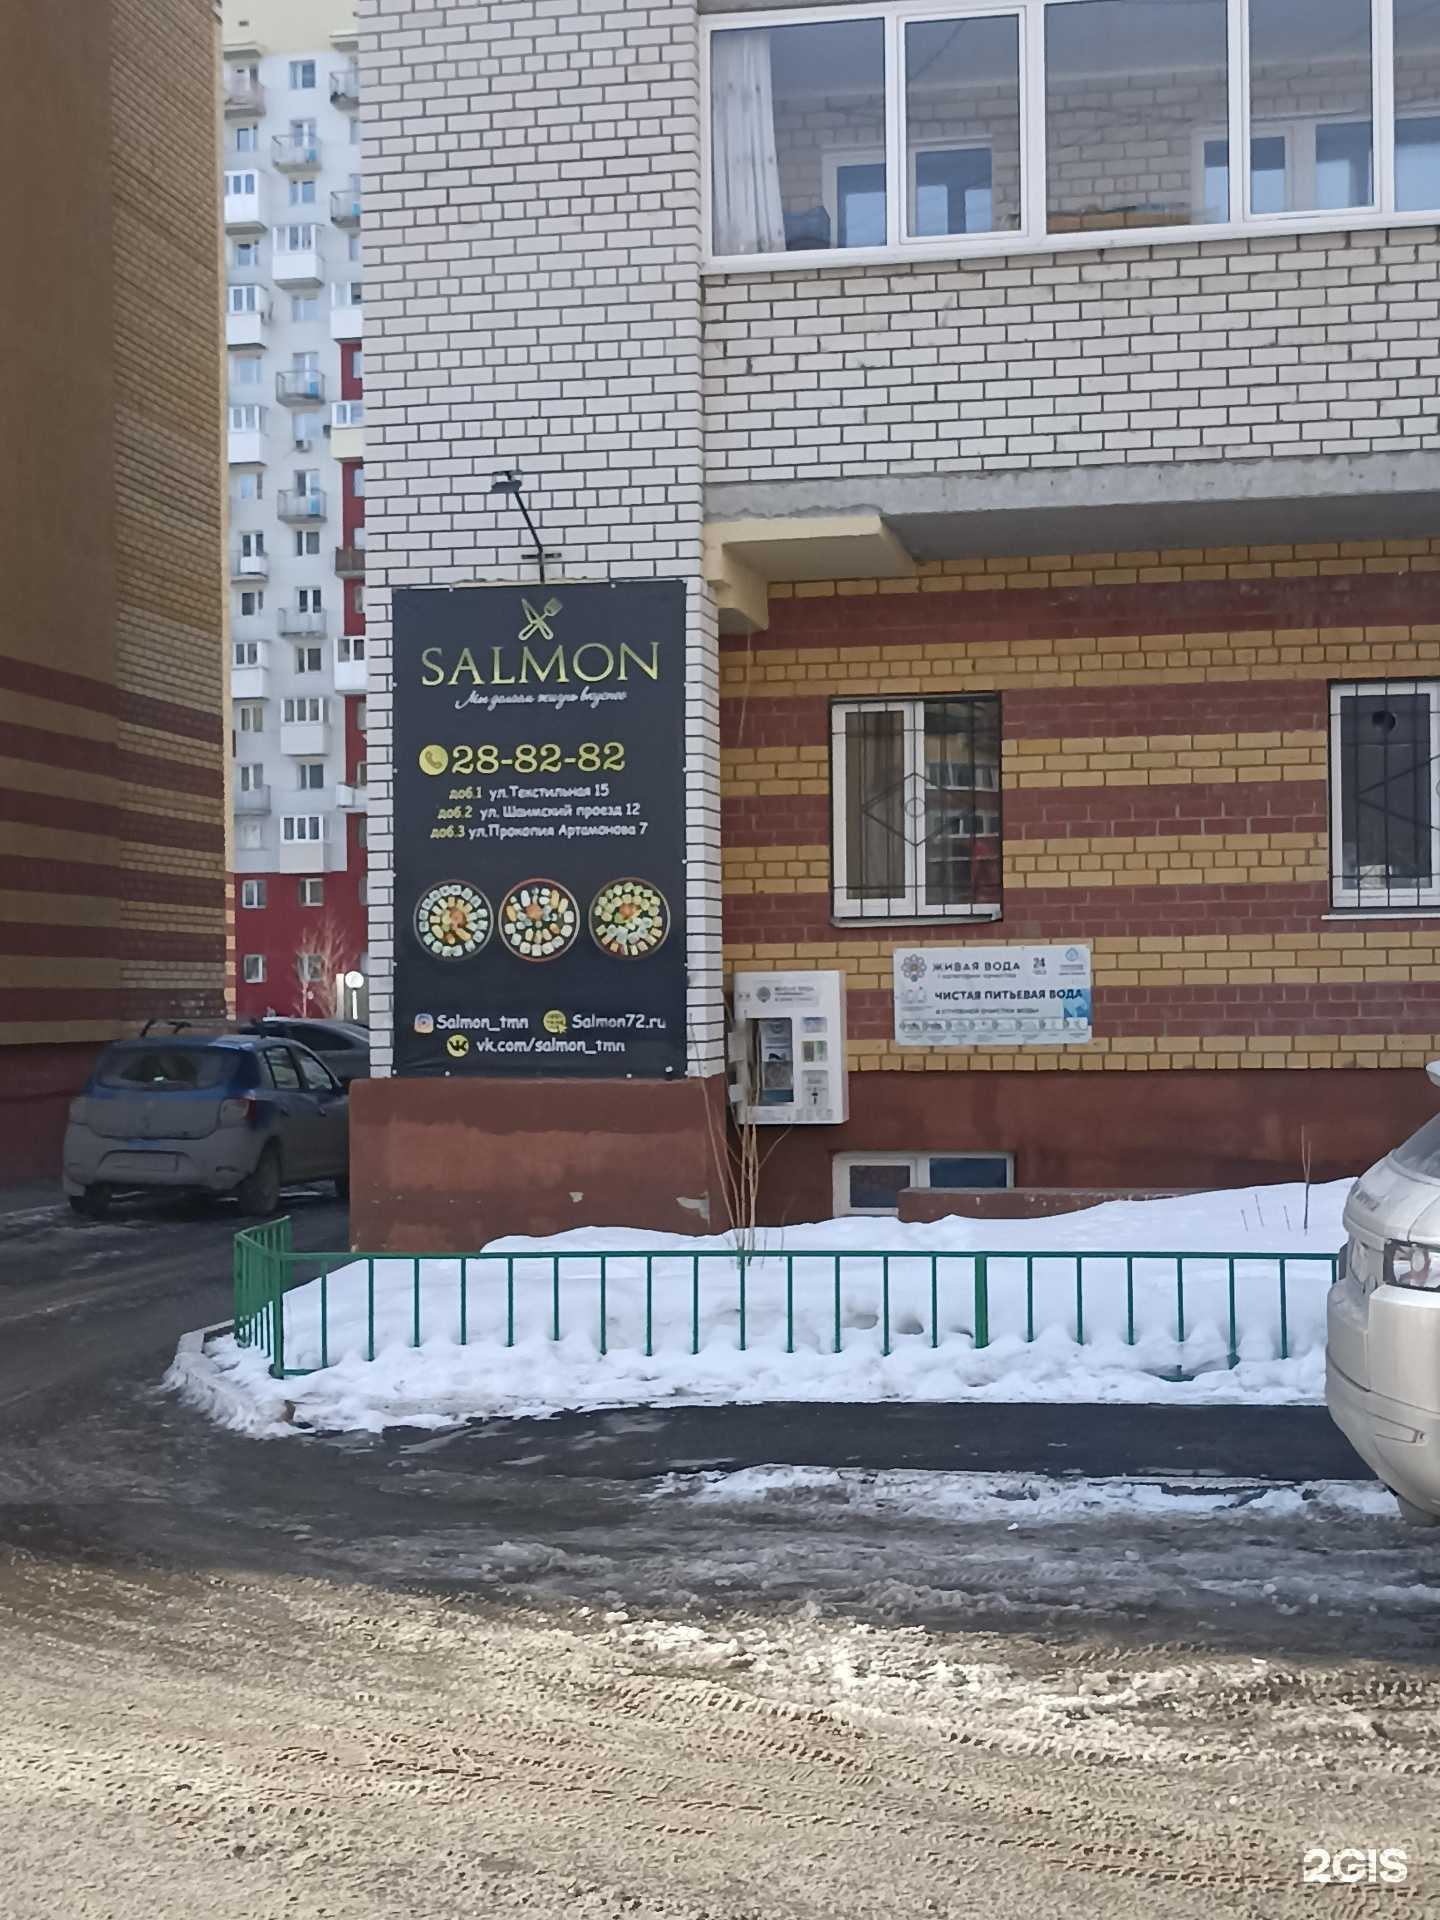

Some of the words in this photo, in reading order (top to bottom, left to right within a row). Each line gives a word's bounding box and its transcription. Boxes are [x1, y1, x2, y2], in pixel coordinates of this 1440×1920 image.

[420, 642, 660, 686] SALMON
[451, 742, 626, 775] 28-82-82
[594, 783, 610, 797] 15
[479, 808, 500, 822] ул.
[576, 806, 623, 820] проезд
[625, 803, 641, 816] 12
[558, 824, 636, 839] Артамонова
[639, 822, 649, 835] 7
[984, 961, 1021, 972] ВОДА
[934, 990, 982, 1001] ЧИСТАЯ
[984, 989, 1045, 1000] ПИТЬЕВАЯ
[1050, 988, 1083, 999] ВОДА
[436, 1014, 529, 1032] Salmon_tmn
[572, 1012, 666, 1029] Salmon72.ru
[476, 1036, 626, 1055] vk.com/salmon_tmn
